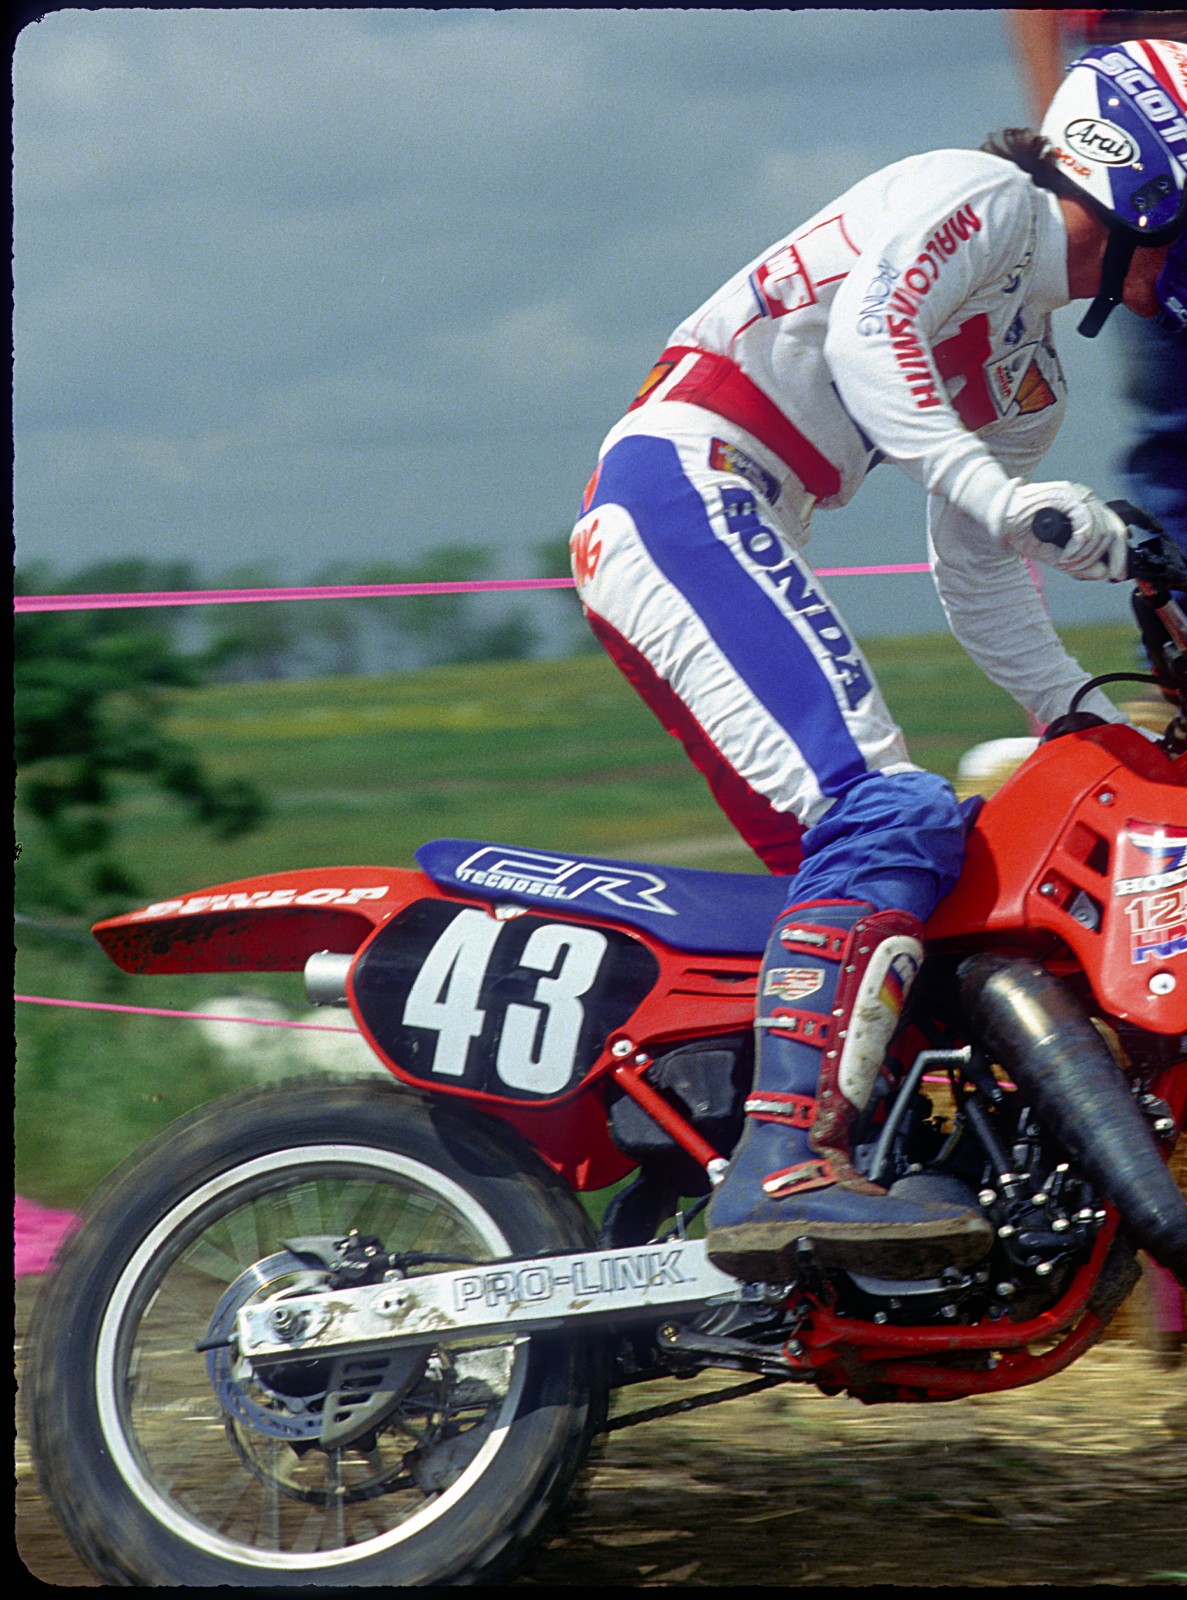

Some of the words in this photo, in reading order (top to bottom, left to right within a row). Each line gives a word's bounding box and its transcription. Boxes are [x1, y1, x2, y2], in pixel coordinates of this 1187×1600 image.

[1066, 123, 1130, 157] Arai
[886, 313, 944, 410] SMITH
[718, 486, 875, 712] HONDA
[131, 885, 390, 921] DUNLOP
[455, 846, 679, 916] CR
[401, 906, 608, 1094] 43
[453, 1249, 686, 1312] PRO-LINK
